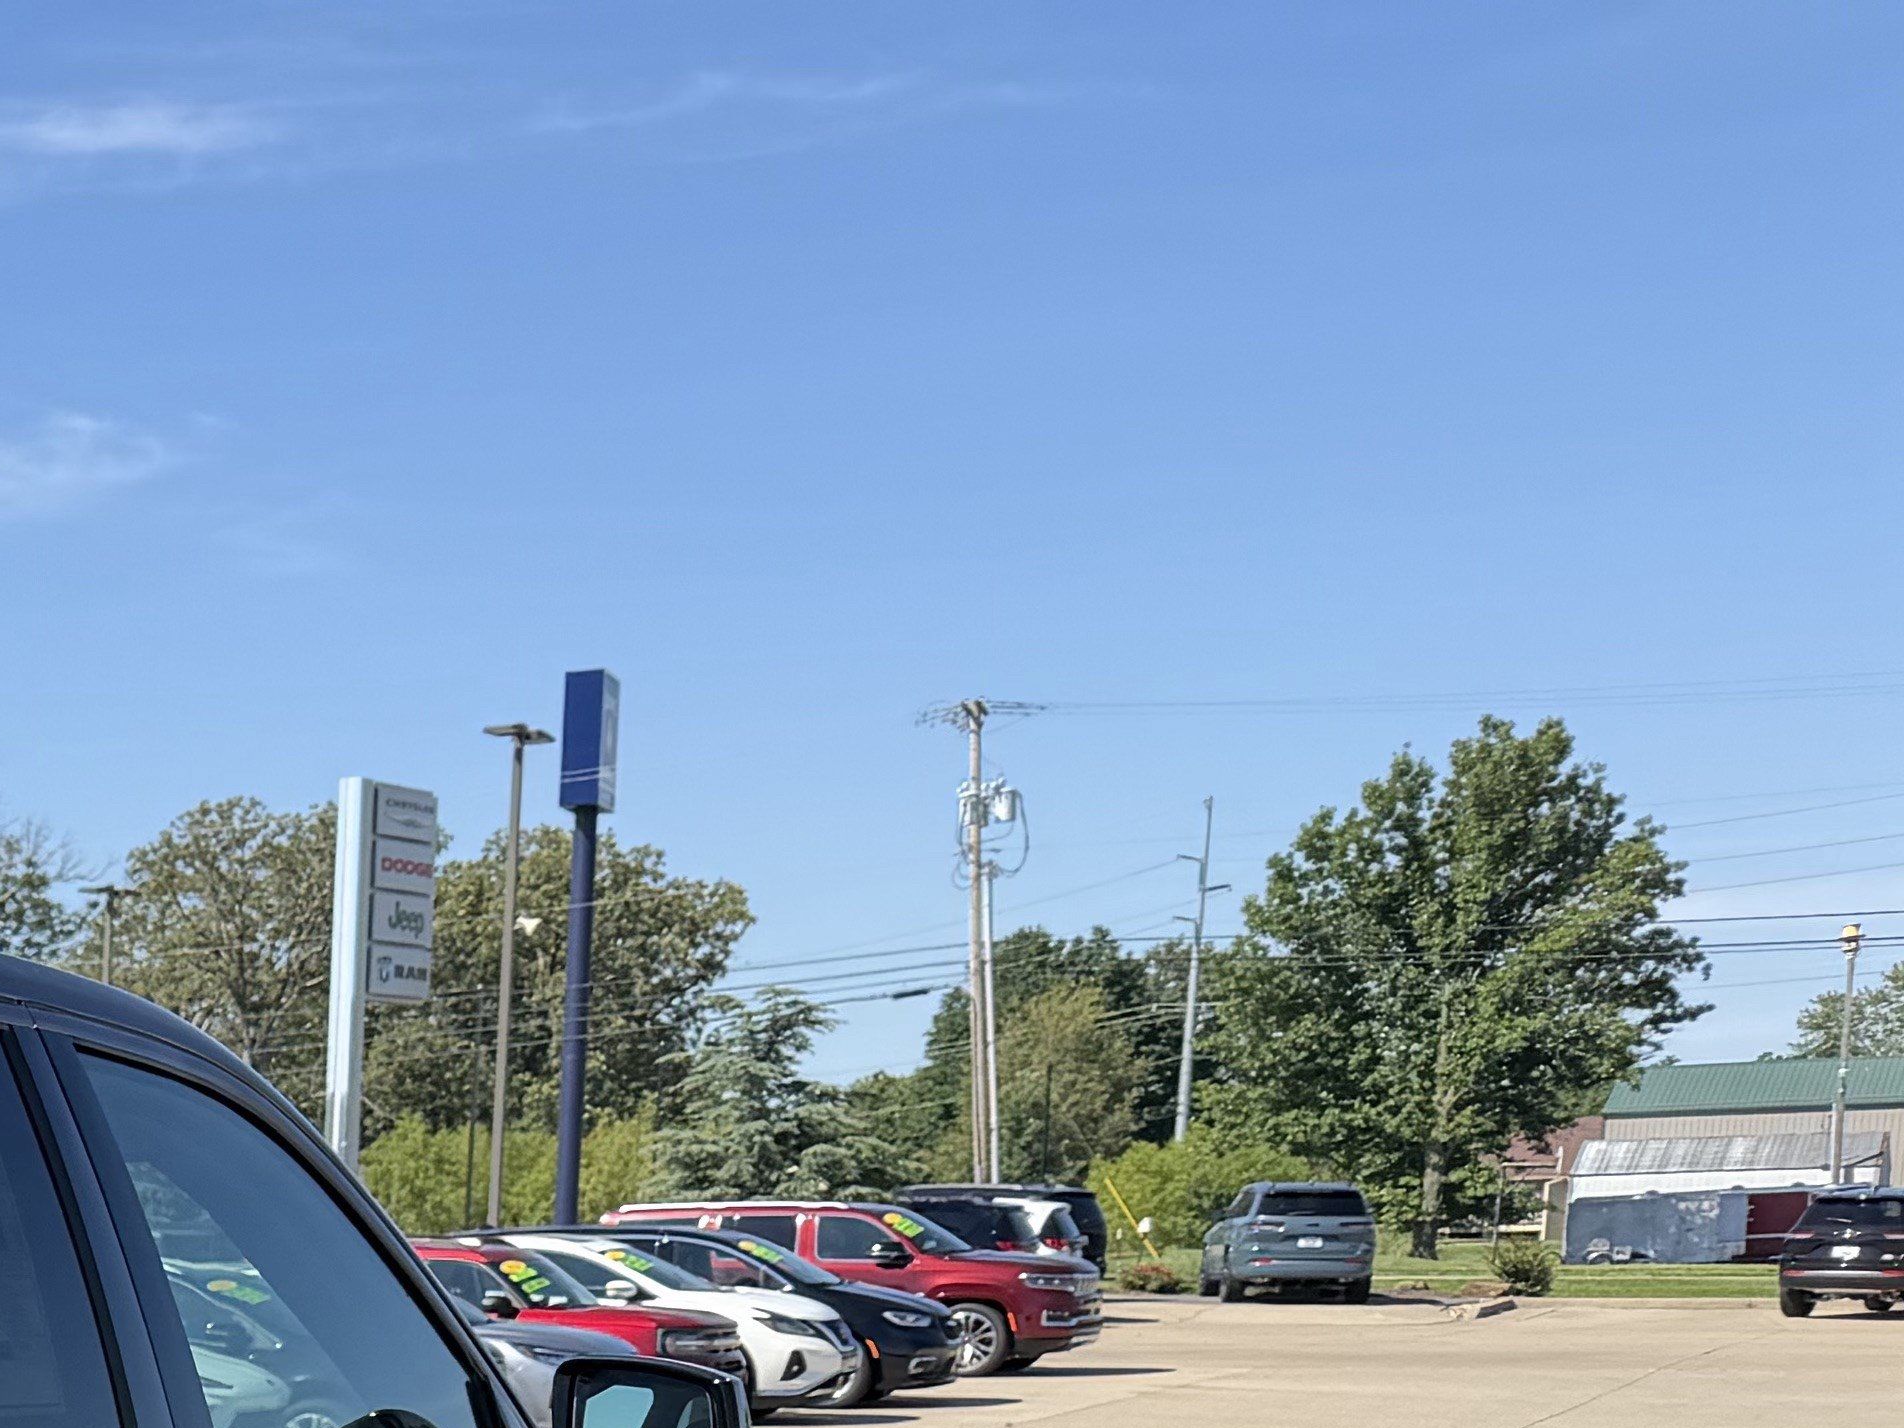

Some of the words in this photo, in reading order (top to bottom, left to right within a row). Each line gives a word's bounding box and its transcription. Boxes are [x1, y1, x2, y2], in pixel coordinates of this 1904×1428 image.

[381, 856, 435, 879] DODGE
[388, 900, 425, 939] Jeep
[394, 963, 428, 982] RAM
